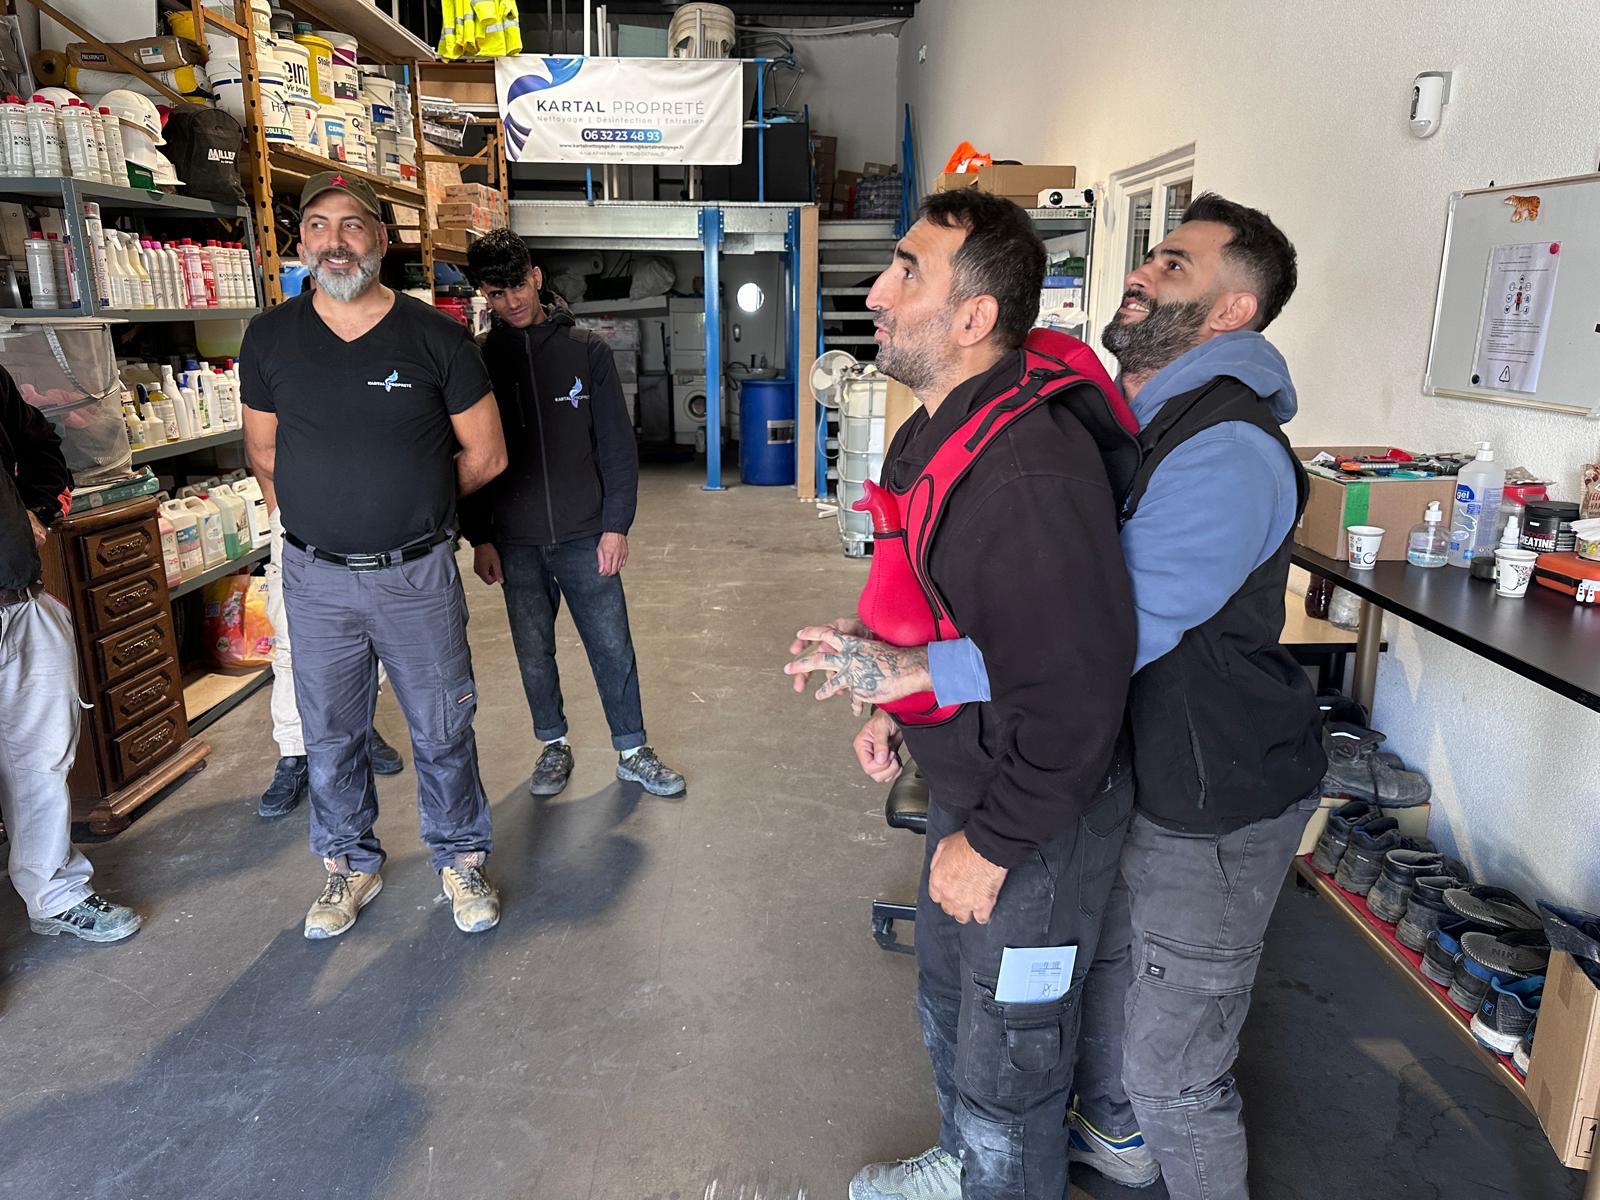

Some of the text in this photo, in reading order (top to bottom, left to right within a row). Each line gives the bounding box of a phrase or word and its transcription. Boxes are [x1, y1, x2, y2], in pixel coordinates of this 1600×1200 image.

[537, 100, 705, 115] KARTAL PROPRETÉ
[537, 116, 705, 125] Nettoyage Désinfection Entretien
[583, 130, 660, 142] 06 32 23 48 93
[1456, 488, 1470, 500] gel
[1491, 948, 1522, 959] NIKE
